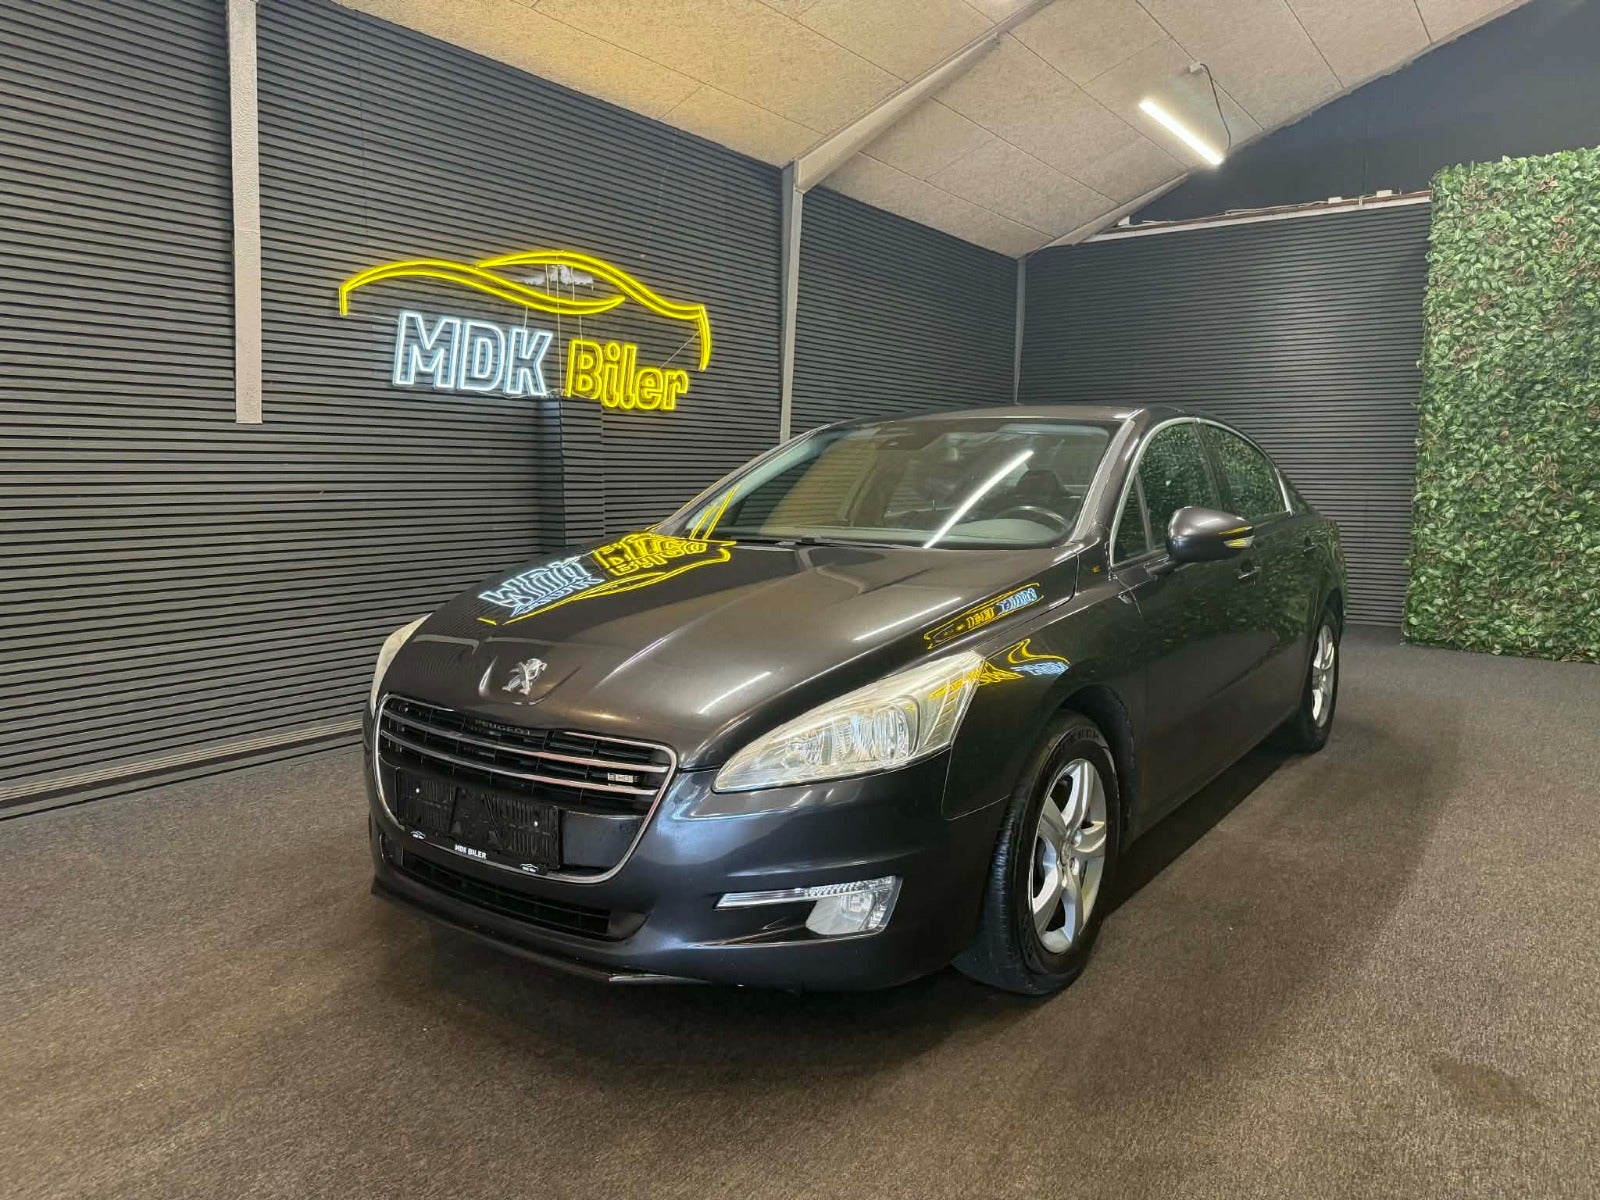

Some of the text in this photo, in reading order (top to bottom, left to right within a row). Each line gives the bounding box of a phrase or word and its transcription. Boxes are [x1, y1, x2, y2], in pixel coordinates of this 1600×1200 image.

[393, 310, 690, 411] MDK Biler
[467, 847, 487, 860] BILER
